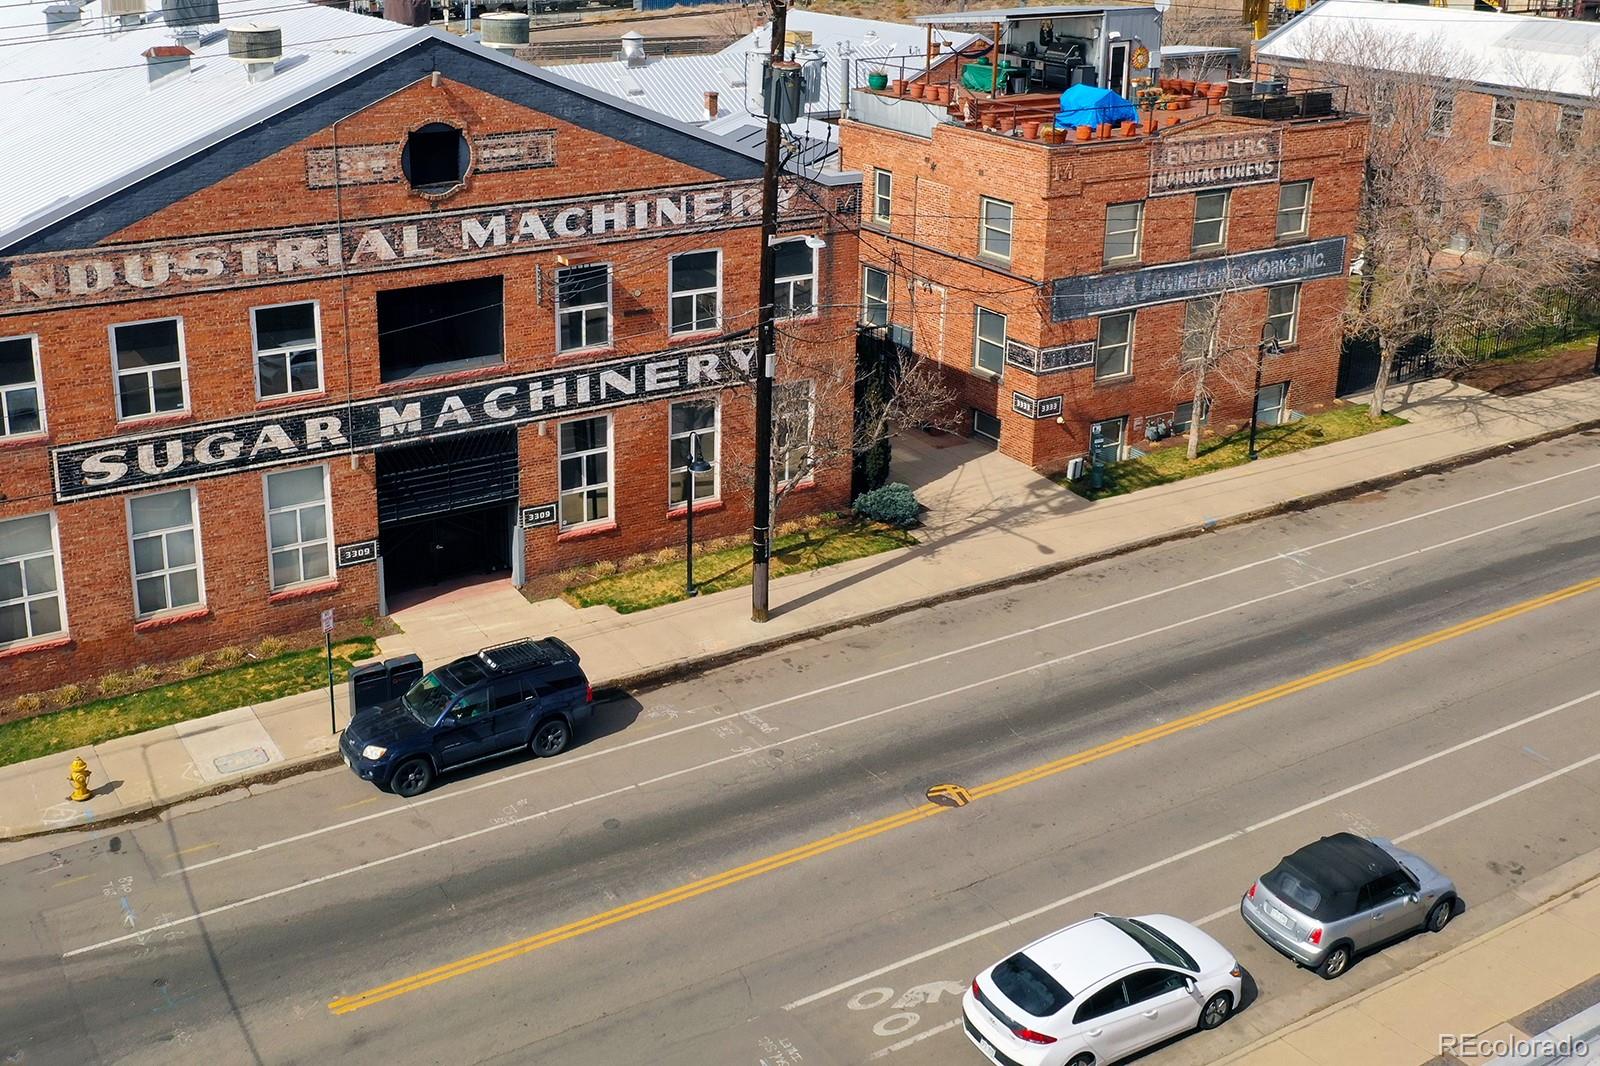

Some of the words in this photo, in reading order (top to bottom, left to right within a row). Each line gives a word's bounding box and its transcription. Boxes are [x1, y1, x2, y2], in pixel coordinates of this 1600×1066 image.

[1166, 137, 1269, 166] ENGINEERS
[1156, 159, 1275, 188] MANUFACTURERS
[461, 183, 798, 250] MACHINERY
[80, 416, 349, 486] SUGAR
[379, 348, 758, 438] MACHINERY
[1041, 402, 1058, 413] 3333
[528, 510, 551, 522] 3309
[344, 547, 371, 560] 3309
